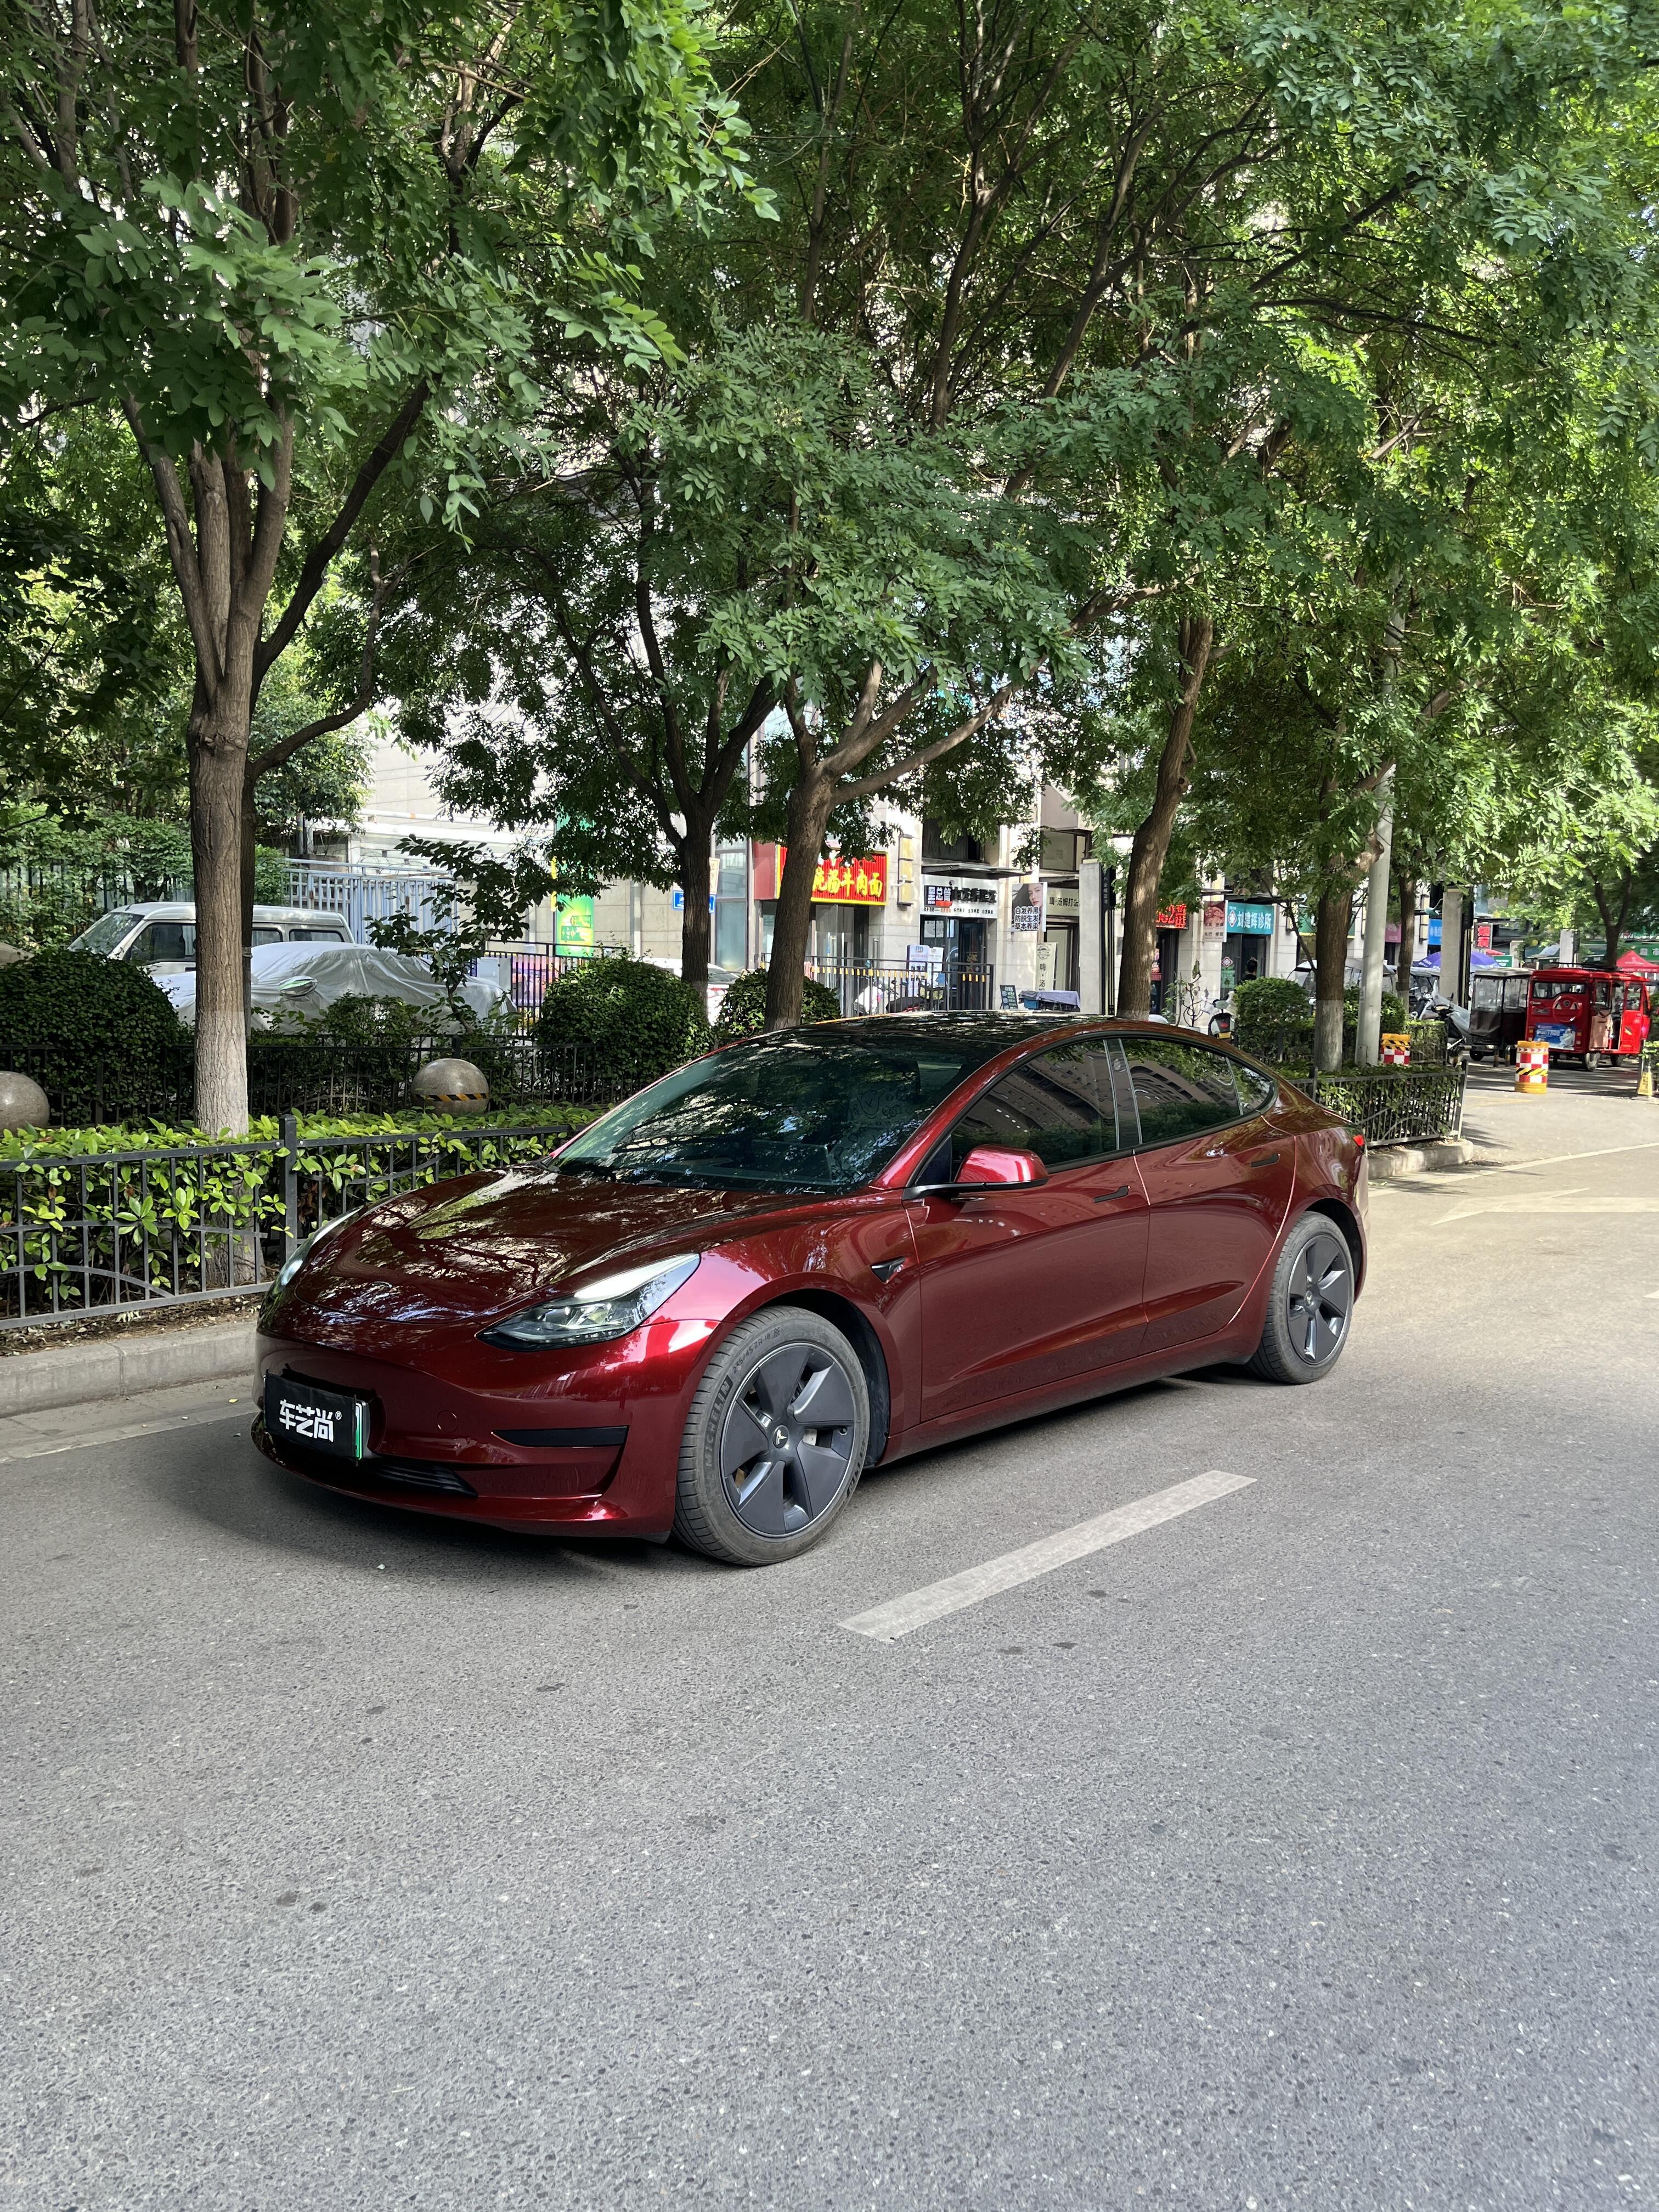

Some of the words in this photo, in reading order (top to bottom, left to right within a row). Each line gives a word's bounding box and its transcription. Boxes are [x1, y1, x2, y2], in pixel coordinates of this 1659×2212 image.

[1237, 911, 1272, 929] 刘建辉诊所
[705, 1380, 731, 1468] MICHELIN
